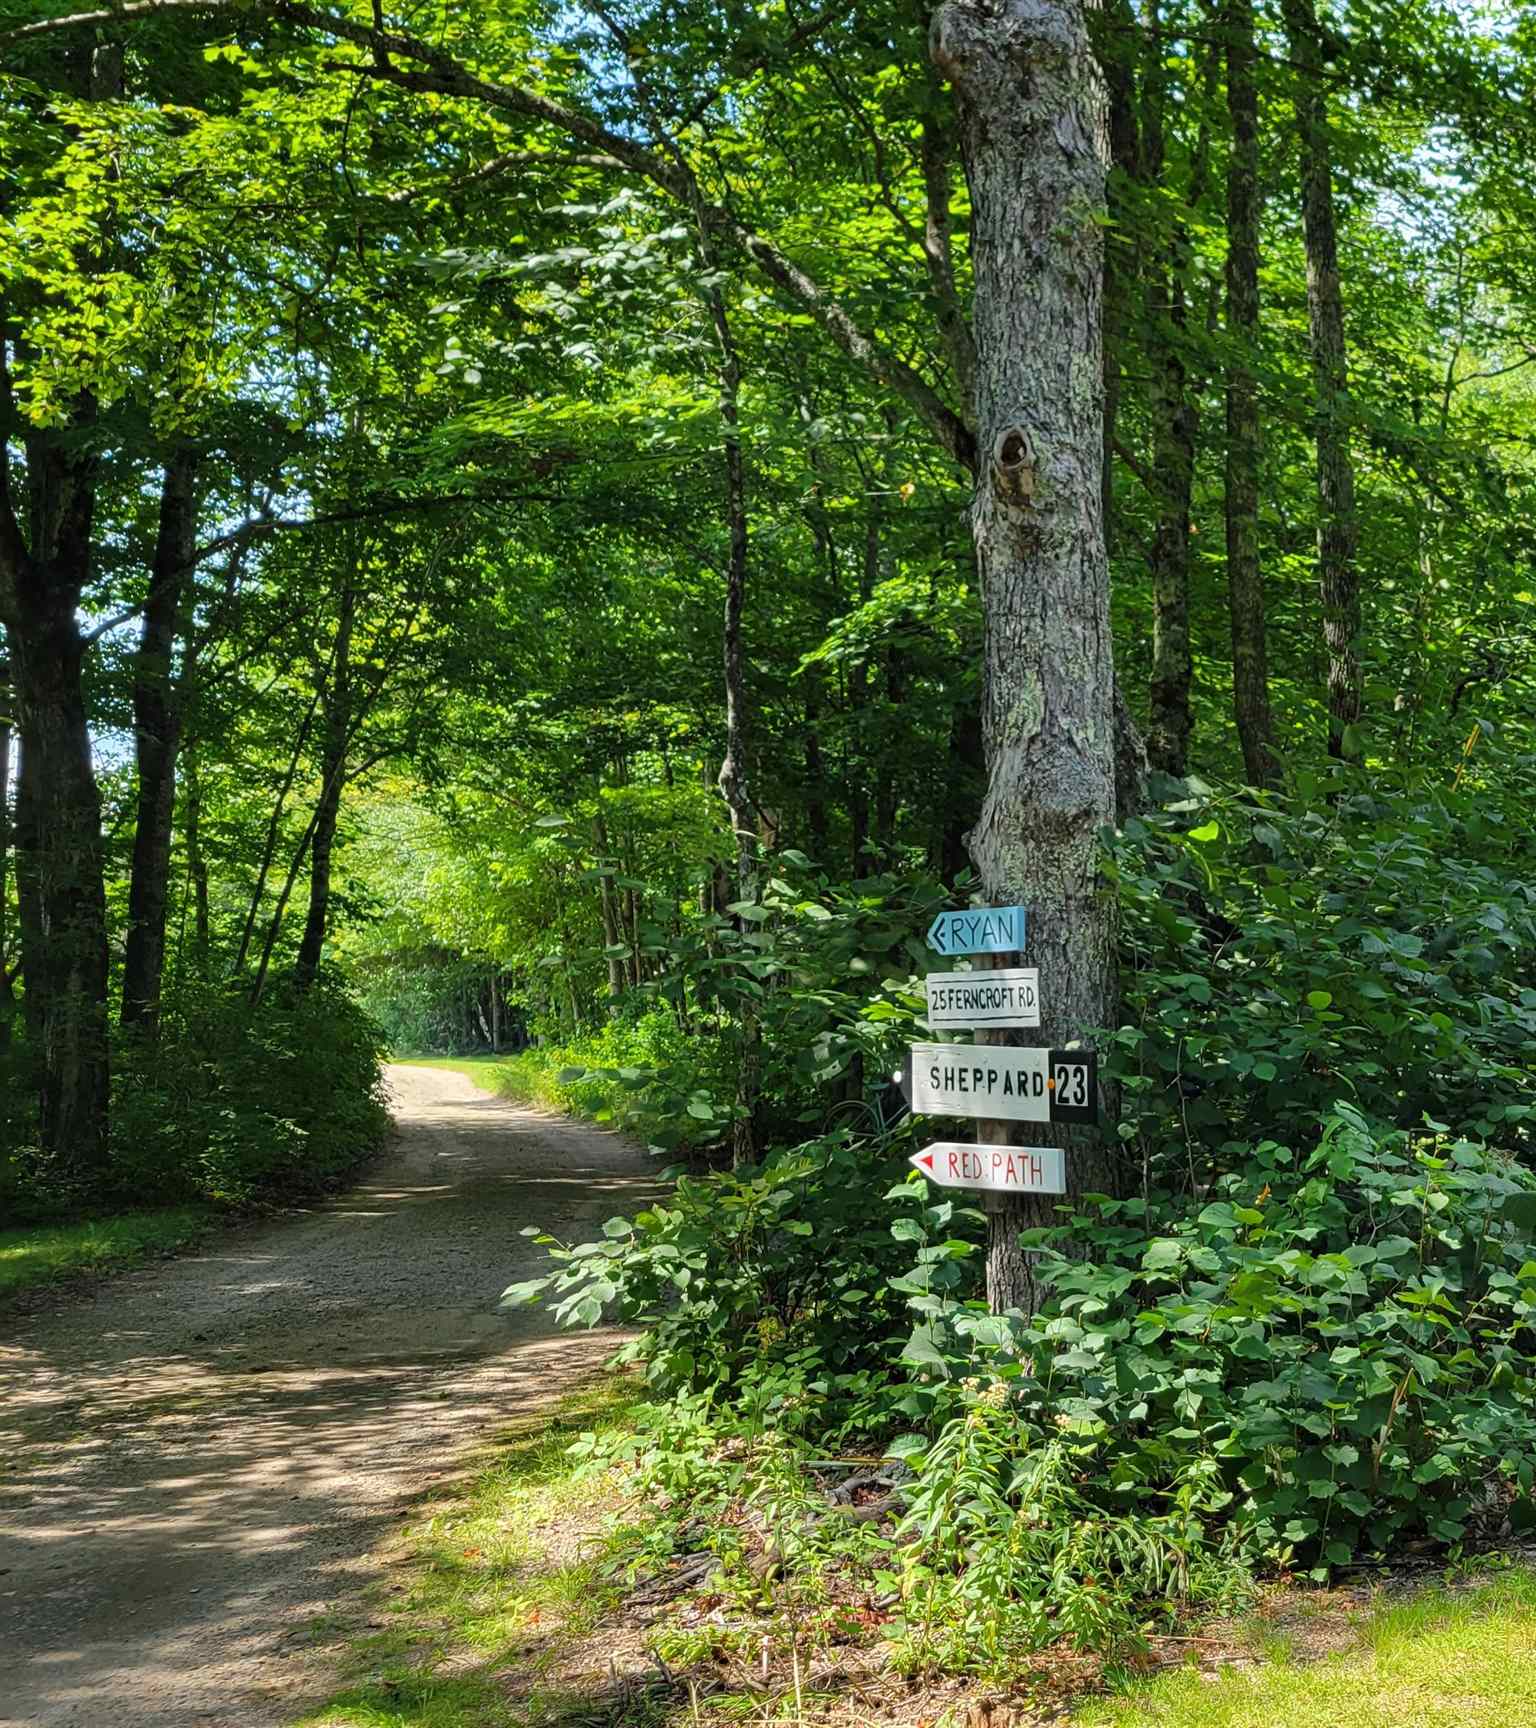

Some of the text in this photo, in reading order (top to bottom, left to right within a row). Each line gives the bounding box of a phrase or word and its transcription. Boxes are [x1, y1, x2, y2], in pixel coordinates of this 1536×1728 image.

[951, 914, 1014, 948] RYAN
[930, 1066, 1044, 1097] SHEPPARD
[1057, 1066, 1087, 1105] 23
[949, 1152, 1043, 1185] RED PATH
